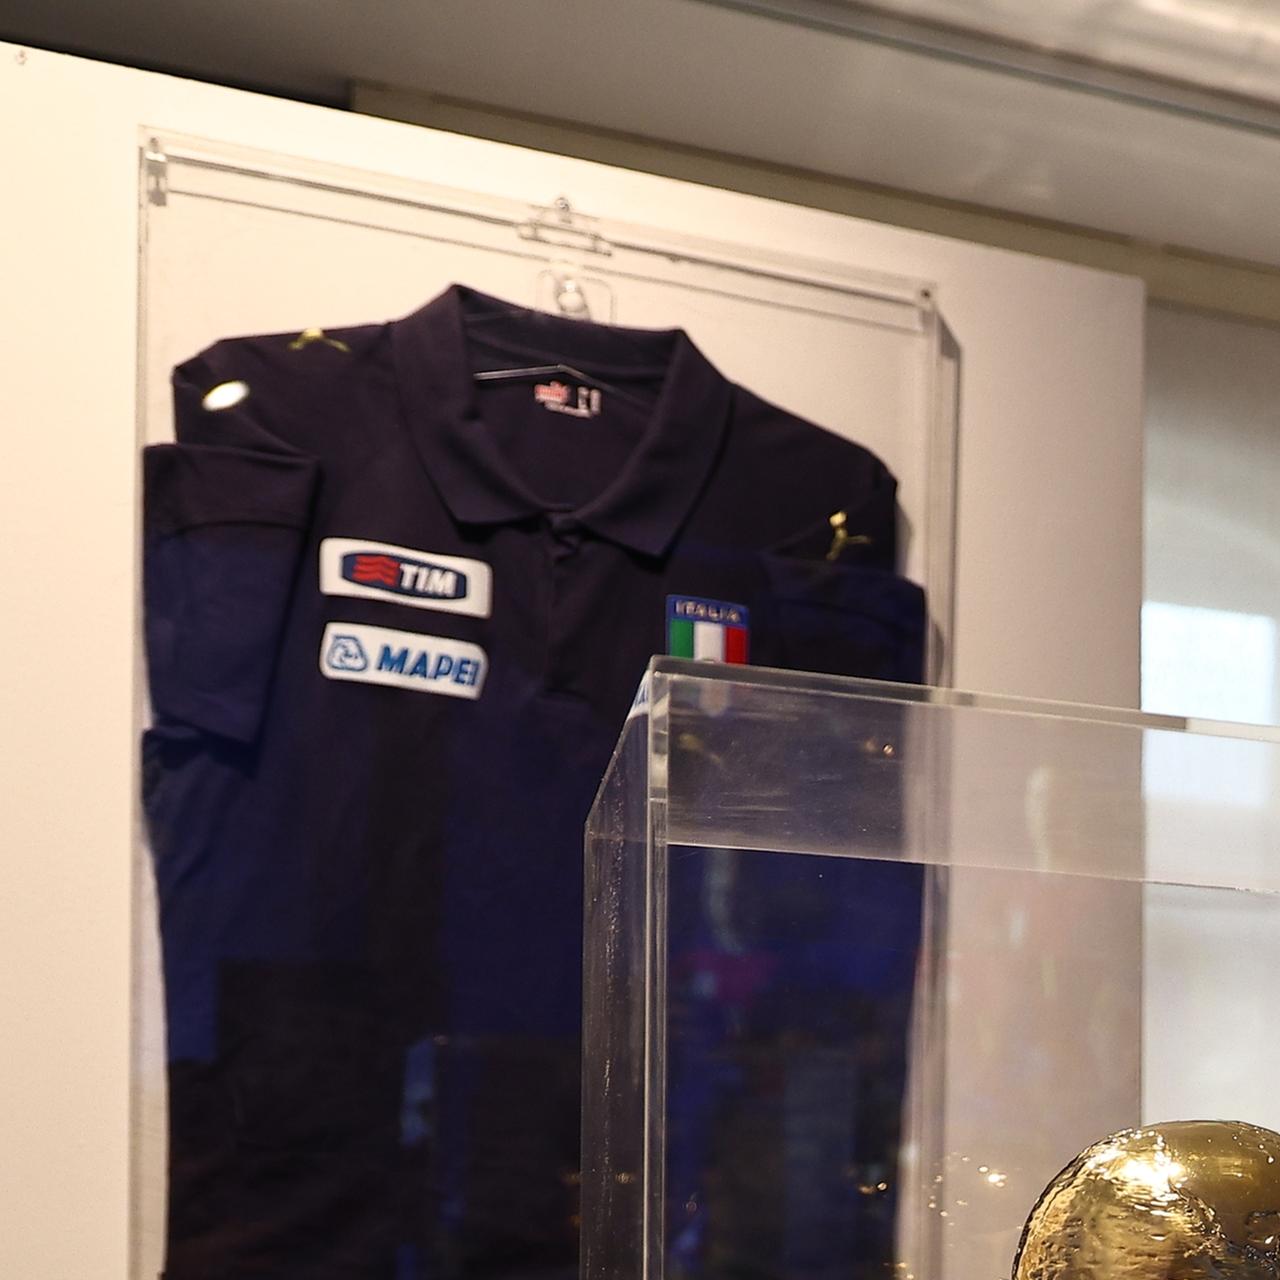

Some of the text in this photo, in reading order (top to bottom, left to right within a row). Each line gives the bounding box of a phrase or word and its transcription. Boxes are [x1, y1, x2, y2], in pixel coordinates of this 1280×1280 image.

[400, 562, 456, 597] TIM
[675, 600, 741, 623] ITALIA
[377, 645, 481, 686] MAPEI
